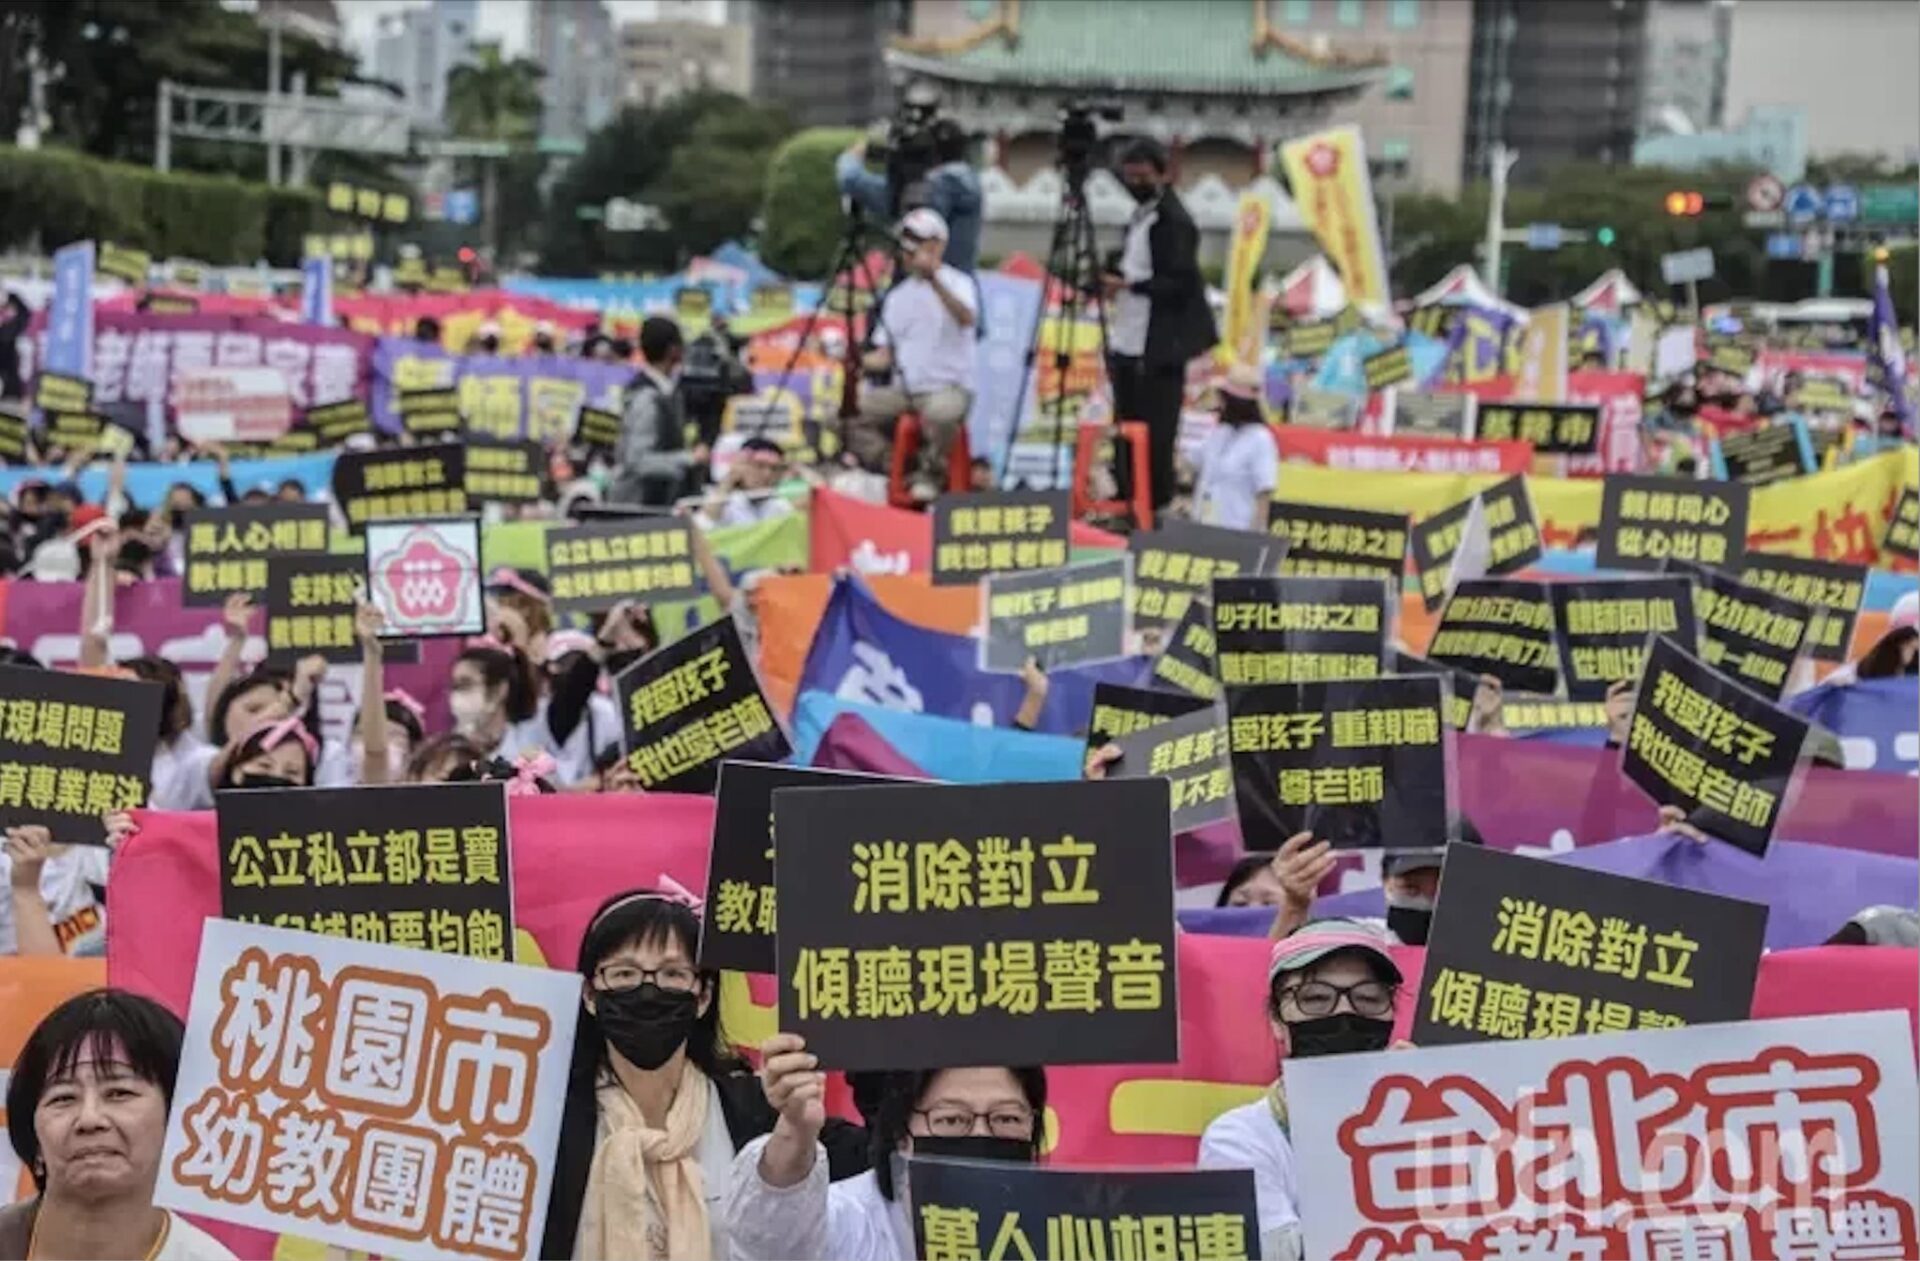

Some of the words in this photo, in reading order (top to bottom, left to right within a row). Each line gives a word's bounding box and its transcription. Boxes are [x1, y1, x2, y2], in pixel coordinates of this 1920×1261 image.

[1216, 603, 1380, 632] 少子化解決之道
[0, 699, 125, 755] 現場問題
[631, 647, 730, 731] 我愛孩子
[1231, 713, 1325, 752] 愛孩子
[1331, 706, 1439, 748] 重親職
[1653, 670, 1777, 765] 我愛孩子
[628, 694, 773, 787] 我也愛老師
[1630, 712, 1777, 828] 我也愛老師
[1279, 766, 1384, 805] 尊老師
[229, 825, 500, 888] 公立私立都是寶
[851, 834, 1100, 914] 消除對立
[791, 937, 1166, 1021] 傾聽現場聲音
[1491, 896, 1700, 990] 消除對立
[214, 950, 550, 1137] 桃園市
[175, 1090, 536, 1259] 幼教團體
[1342, 1049, 1877, 1221] 台北市
